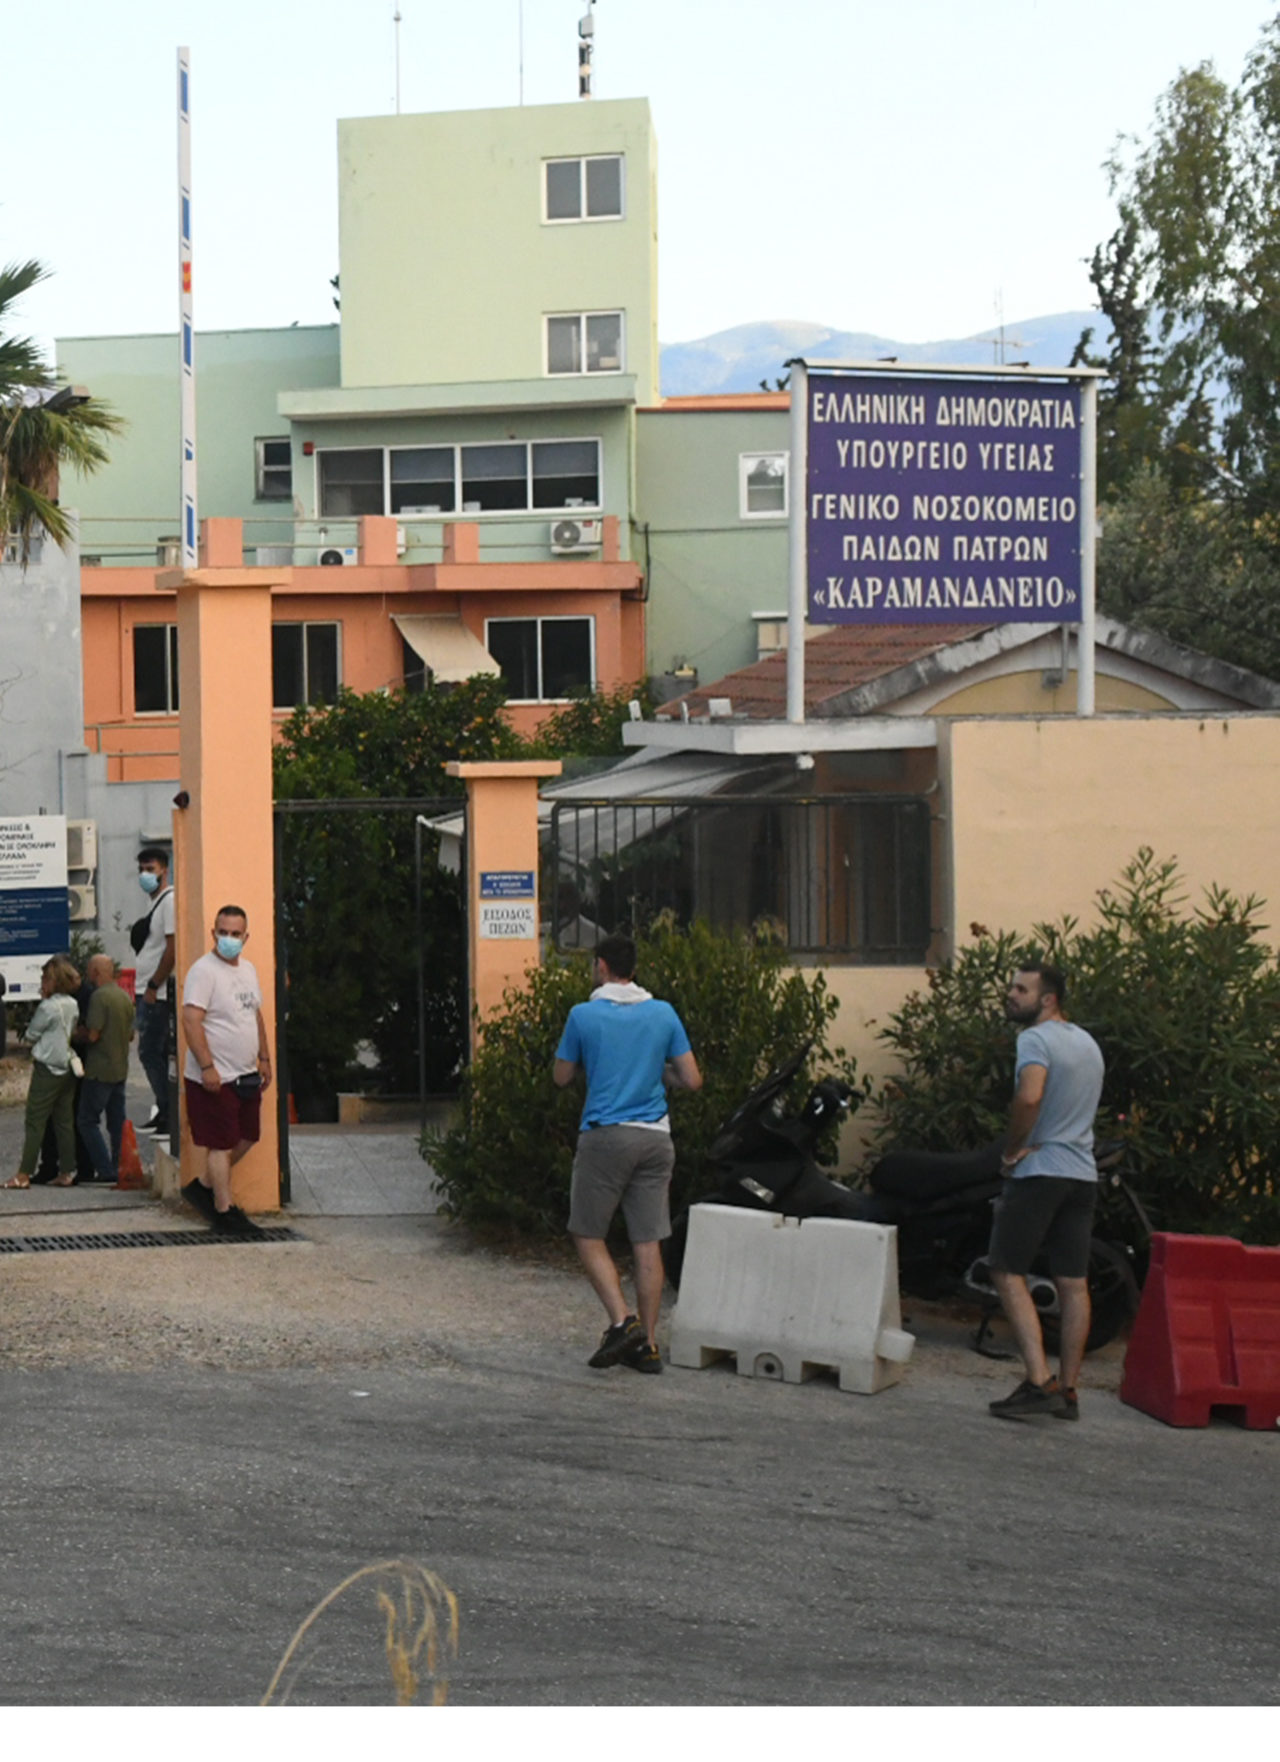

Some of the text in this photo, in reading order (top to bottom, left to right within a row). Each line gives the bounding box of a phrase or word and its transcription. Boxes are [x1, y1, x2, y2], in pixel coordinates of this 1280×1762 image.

[813, 392, 1076, 429] ΕΛΛΗΝΙΚΗ ΔΗΜΟΚΡΑΤΙΑ
[836, 439, 1055, 472] ΥΠΟΥΡΓΕΙΟ ΥΓΕΙΑΣ
[811, 493, 1077, 523] ΓΕΝΙΚΟ ΝΟΣΟΚΟΜΕΙΟ
[842, 535, 1048, 562] ΠΑΙΔΩΝ ΠΑΤΡΩΝ
[813, 576, 1076, 609] «ΚΑΡΑΜΑΝΔΑΝΕΙΟ»
[483, 908, 532, 921] ΕΙΣΟΔΟΣ
[489, 922, 526, 935] ΠΕΖΩΝ
